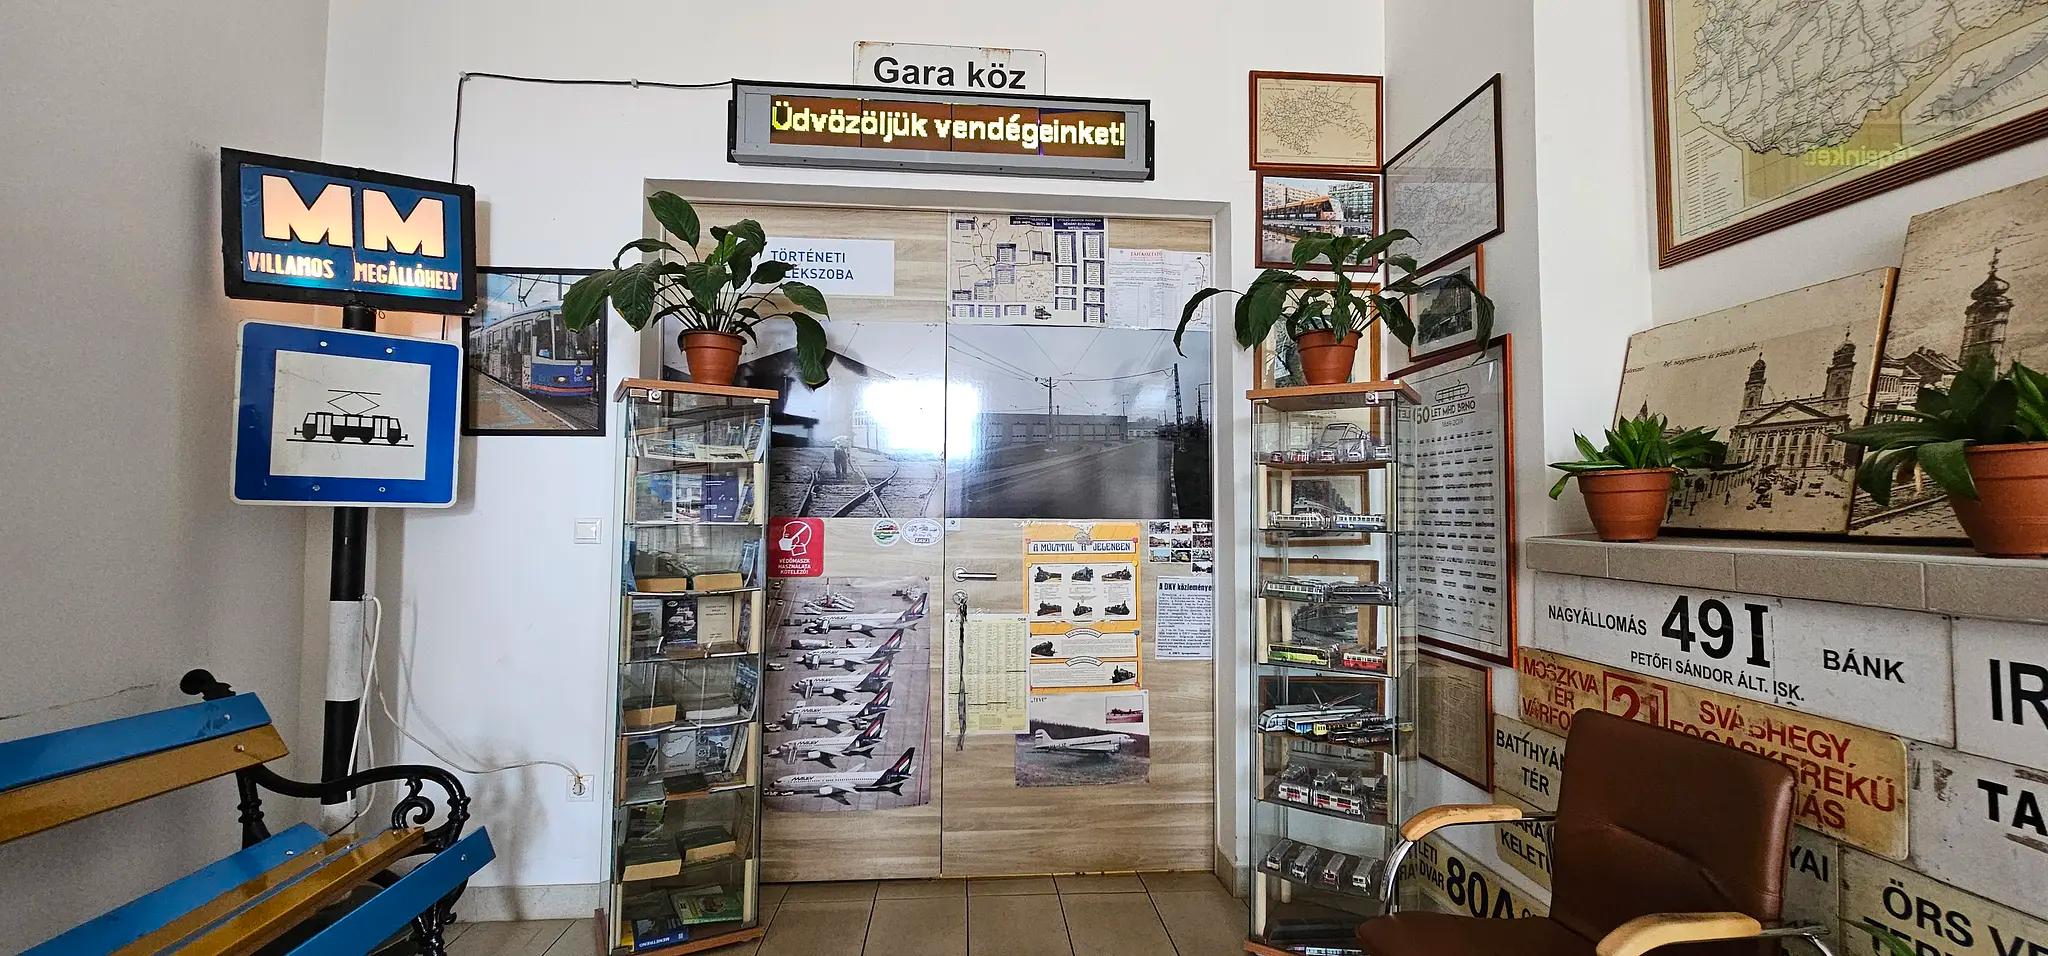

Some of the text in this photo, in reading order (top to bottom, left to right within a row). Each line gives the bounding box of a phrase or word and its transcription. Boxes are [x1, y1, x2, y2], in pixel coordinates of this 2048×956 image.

[873, 56, 1026, 90] Gara köz
[771, 100, 1126, 149] Üdvözöljük vendégeinket!
[261, 174, 445, 258] MM
[247, 250, 459, 291] VILLAMOS MEGÁLLÓHELY
[771, 248, 846, 264] TÖRTÉNETI
[1431, 407, 1441, 418] LET
[1442, 404, 1456, 416] MHD
[1457, 400, 1476, 412] BRNO
[1033, 543, 1038, 552] A
[1093, 542, 1130, 551] JELENBEN
[1159, 582, 1163, 590] A
[1164, 583, 1176, 591] DKV
[1549, 605, 1647, 636] NAGYÁLLOMÁS
[1823, 648, 1905, 684] BÁNK
[1523, 656, 1600, 696] MOSZKVA
[1631, 650, 1805, 702] PETŐFI SÁNDOR ÁLT. ISK.
[1522, 697, 1576, 731] VÁRFO
[1521, 766, 1550, 797] TÉR
[1882, 878, 1974, 948] ÖRS
